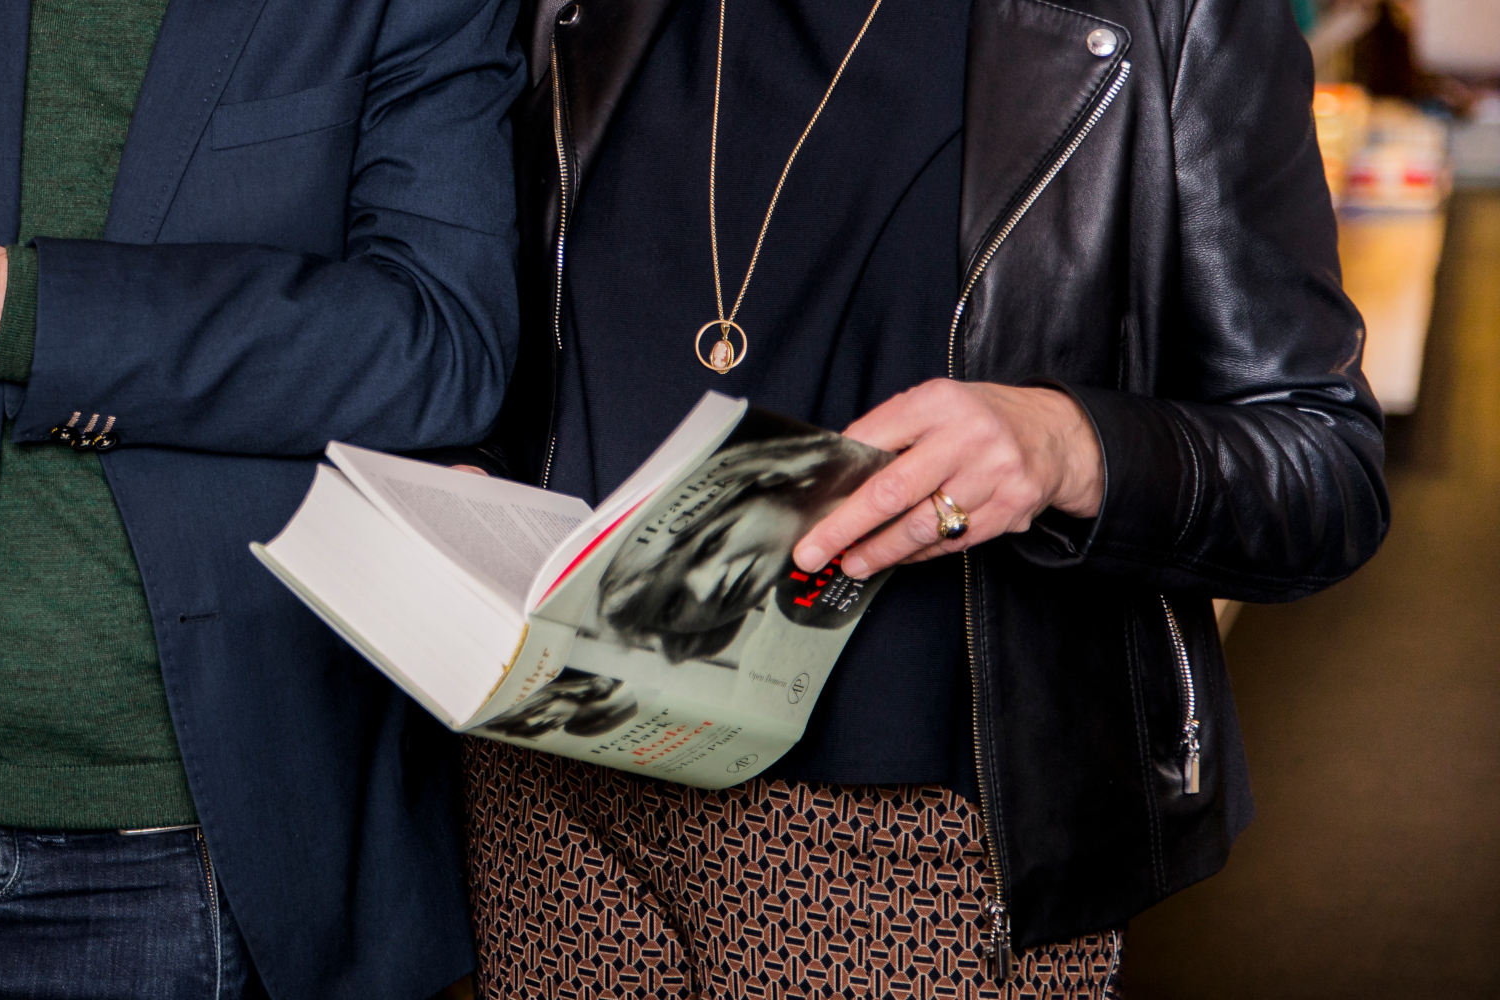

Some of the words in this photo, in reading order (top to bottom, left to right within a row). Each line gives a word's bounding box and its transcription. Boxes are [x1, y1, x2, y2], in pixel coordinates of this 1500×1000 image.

[636, 456, 730, 546] Heather
[668, 477, 734, 536] Clark
[749, 670, 765, 682] Open
[764, 673, 788, 688] Domein
[590, 707, 670, 755] Heather
[617, 721, 674, 752] Clark
[631, 724, 688, 757] Rode
[632, 719, 716, 766] komeet
[663, 751, 707, 774] Sylvia
[707, 726, 743, 752] Plath
